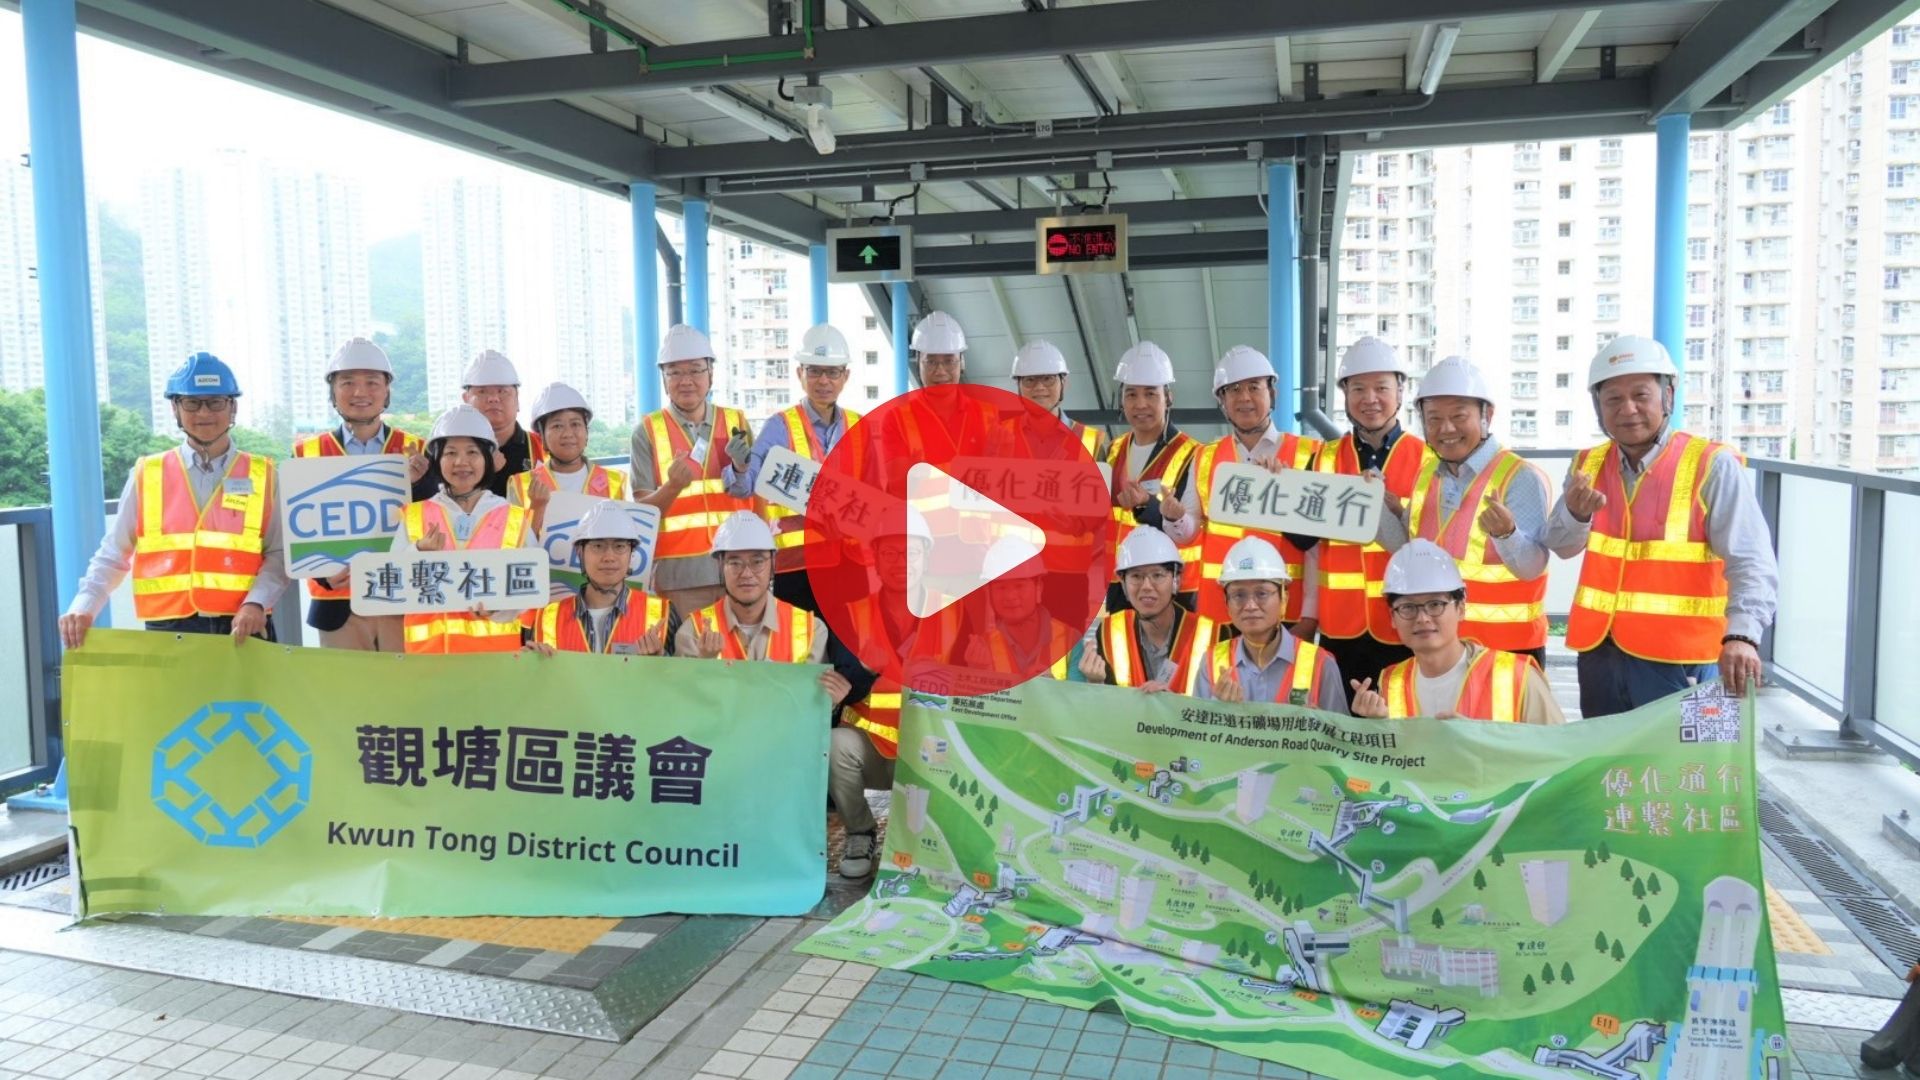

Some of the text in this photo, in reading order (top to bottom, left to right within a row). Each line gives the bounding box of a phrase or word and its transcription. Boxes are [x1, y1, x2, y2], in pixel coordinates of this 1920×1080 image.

[1068, 242, 1115, 255] NO ENTRY
[1219, 474, 1373, 527] 優化通行
[362, 560, 540, 604] 連繫社區
[356, 724, 712, 805] 觀塘區議會
[1137, 722, 1425, 769] Development of Anderson Road Quarry Site Project
[1604, 801, 1742, 836] 連繫社區
[327, 821, 739, 867] Kwun Tong District Council
